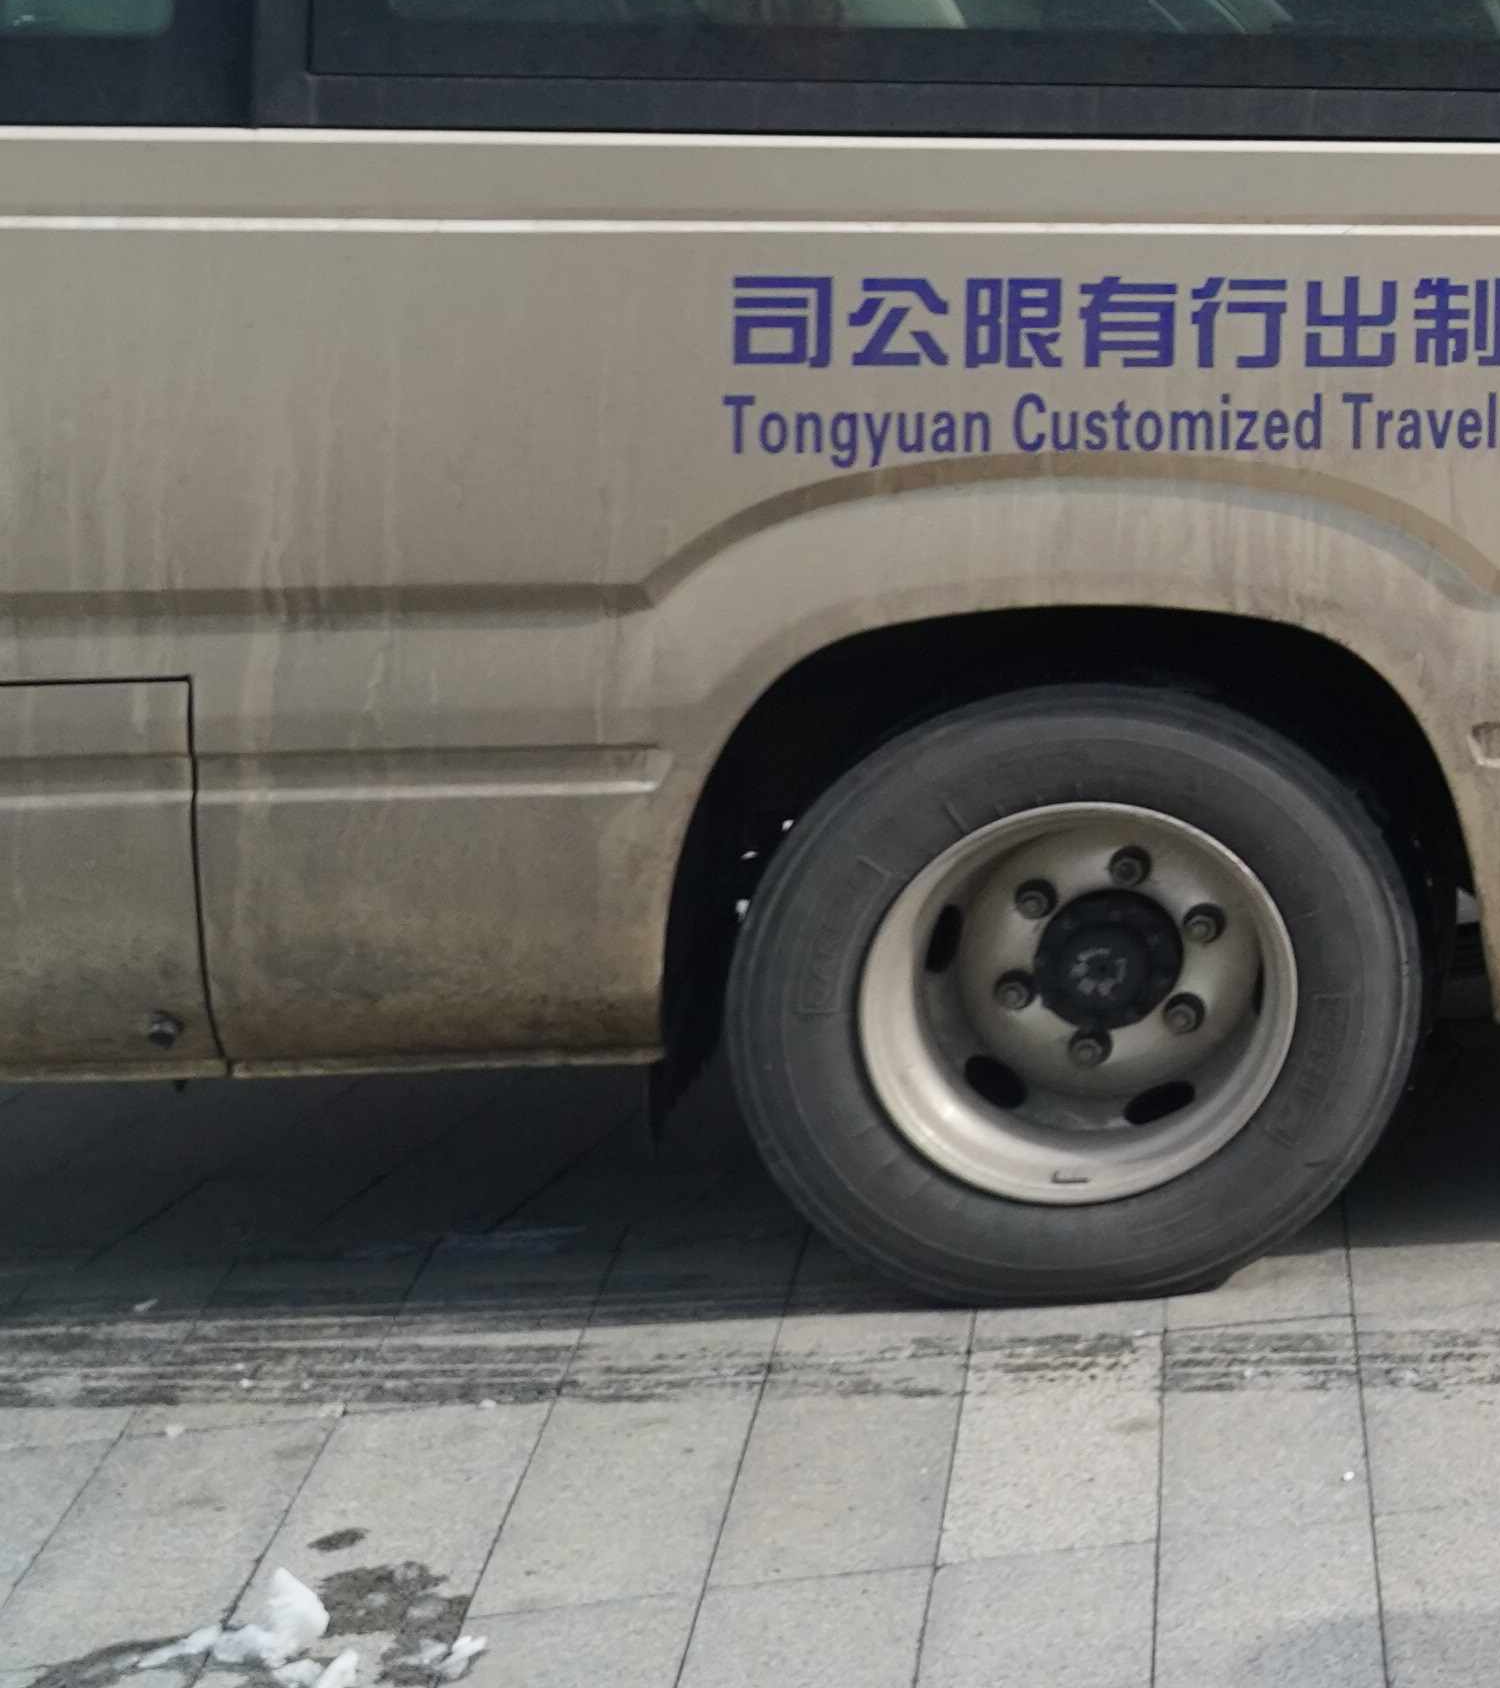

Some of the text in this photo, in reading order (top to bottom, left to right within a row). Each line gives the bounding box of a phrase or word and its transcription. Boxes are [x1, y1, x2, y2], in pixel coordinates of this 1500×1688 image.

[722, 394, 990, 468] Tongyuan
[1012, 391, 1323, 452] Customized
[1342, 391, 1498, 450] Travel
